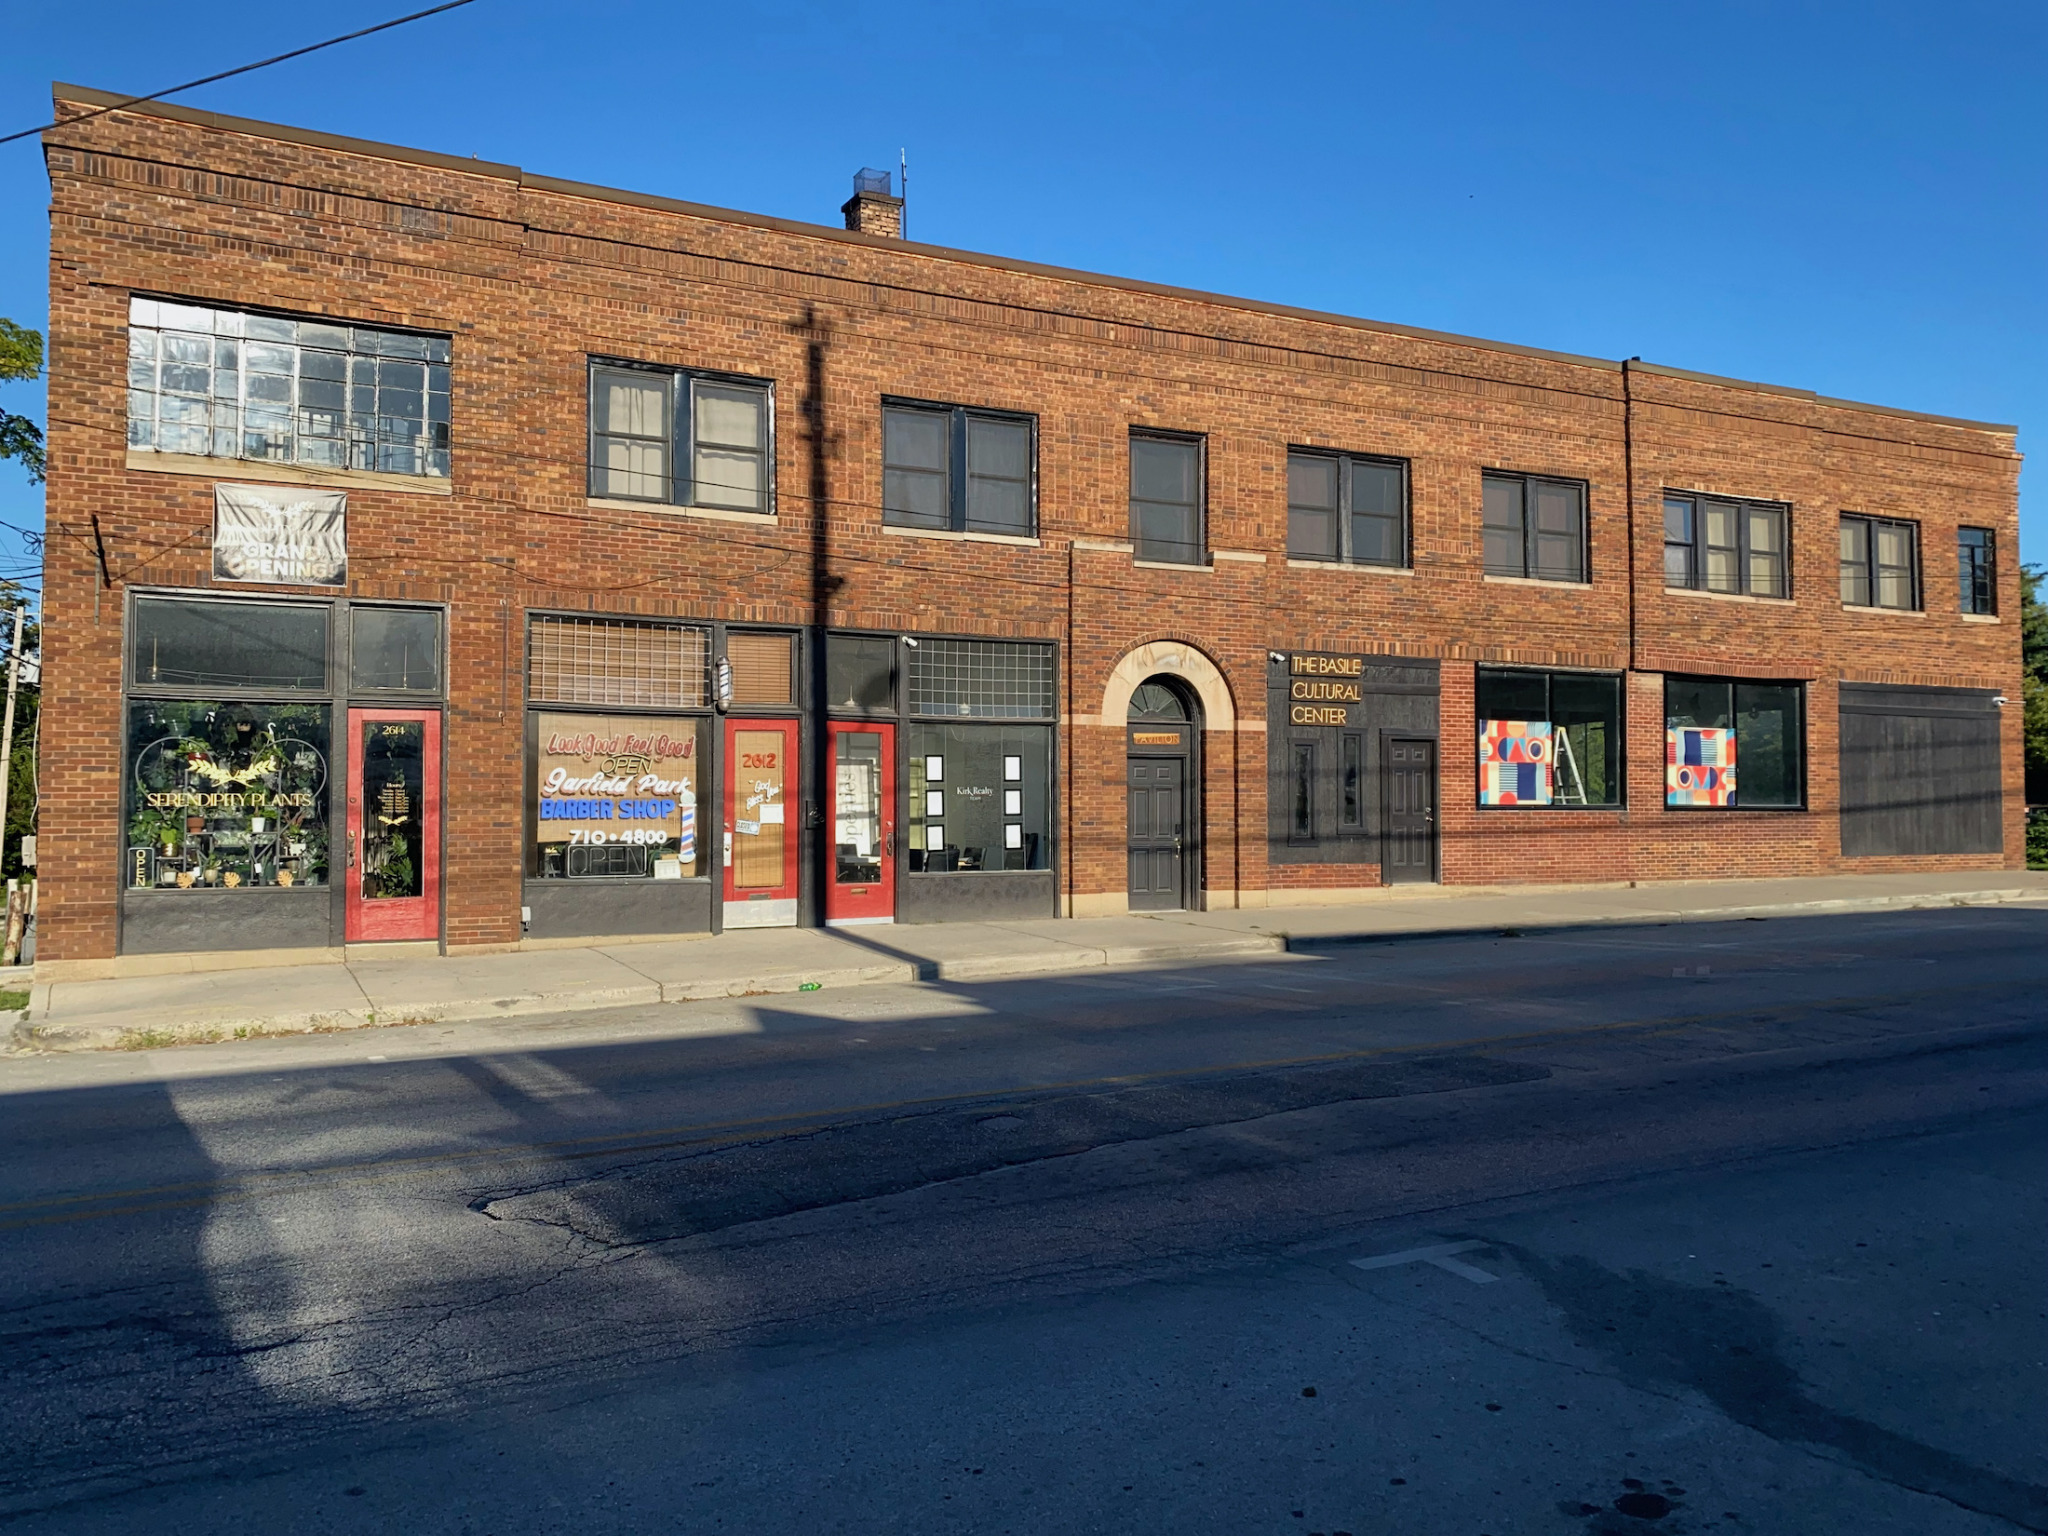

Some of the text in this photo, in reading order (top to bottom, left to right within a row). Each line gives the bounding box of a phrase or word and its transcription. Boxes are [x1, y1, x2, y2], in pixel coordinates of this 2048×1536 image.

[1293, 656, 1361, 675] THE BASILE
[1292, 681, 1361, 700] CULTURAL
[1292, 706, 1346, 724] CENTER
[382, 725, 405, 735] 2614
[548, 733, 582, 754] Look
[622, 734, 654, 755] Feel
[656, 733, 695, 762] Good
[601, 758, 654, 775] OPEN
[742, 753, 776, 768] 2612
[635, 774, 691, 796] Park
[956, 786, 993, 797] Kirk Realty
[147, 793, 312, 807] SERENDIPITY PLANTS
[540, 799, 675, 820] BARBER SHOP
[135, 849, 146, 887] OPEN
[570, 847, 645, 875] OPEN
